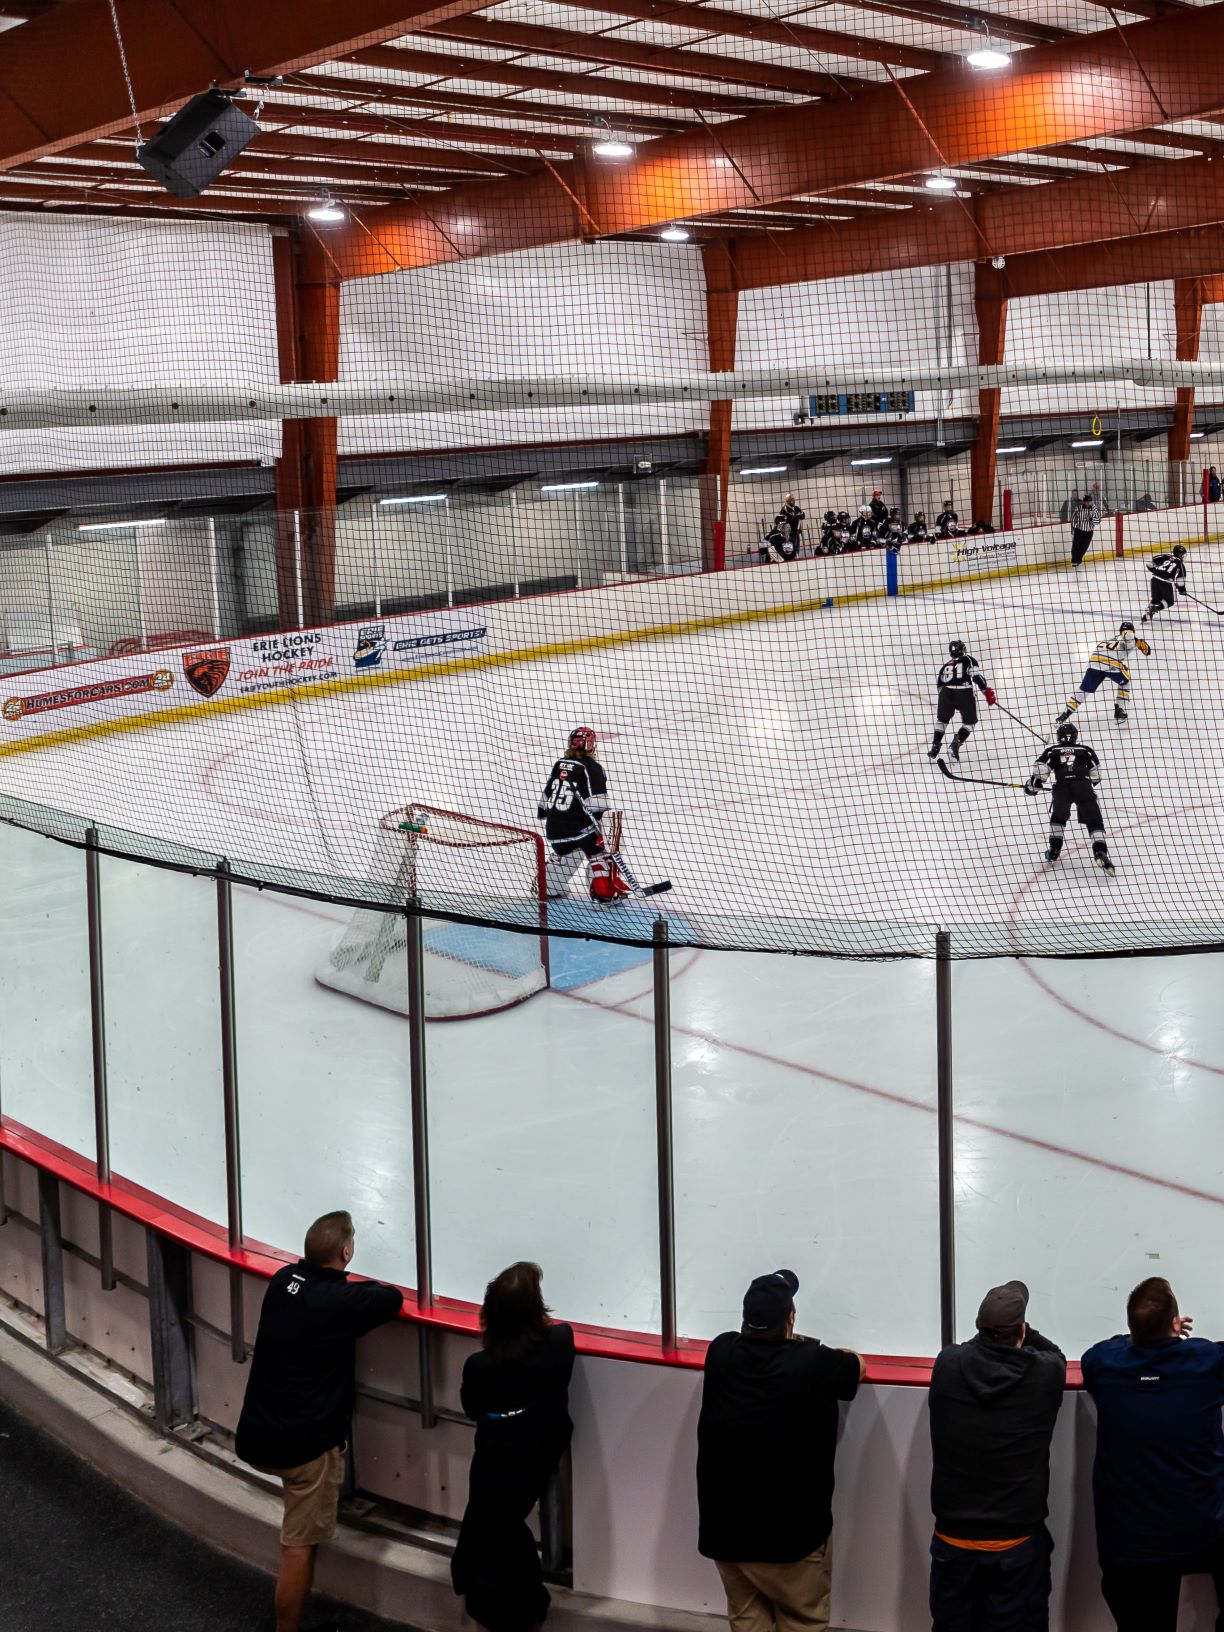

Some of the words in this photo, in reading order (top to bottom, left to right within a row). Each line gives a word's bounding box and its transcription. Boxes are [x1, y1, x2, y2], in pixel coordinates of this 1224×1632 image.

[957, 547, 979, 556] High
[981, 542, 1016, 552] Voltage
[253, 639, 278, 652] ERIE
[283, 633, 321, 648] LIONS
[262, 646, 314, 662] HOCKEY
[236, 667, 269, 682] JOIN
[272, 663, 295, 676] THE
